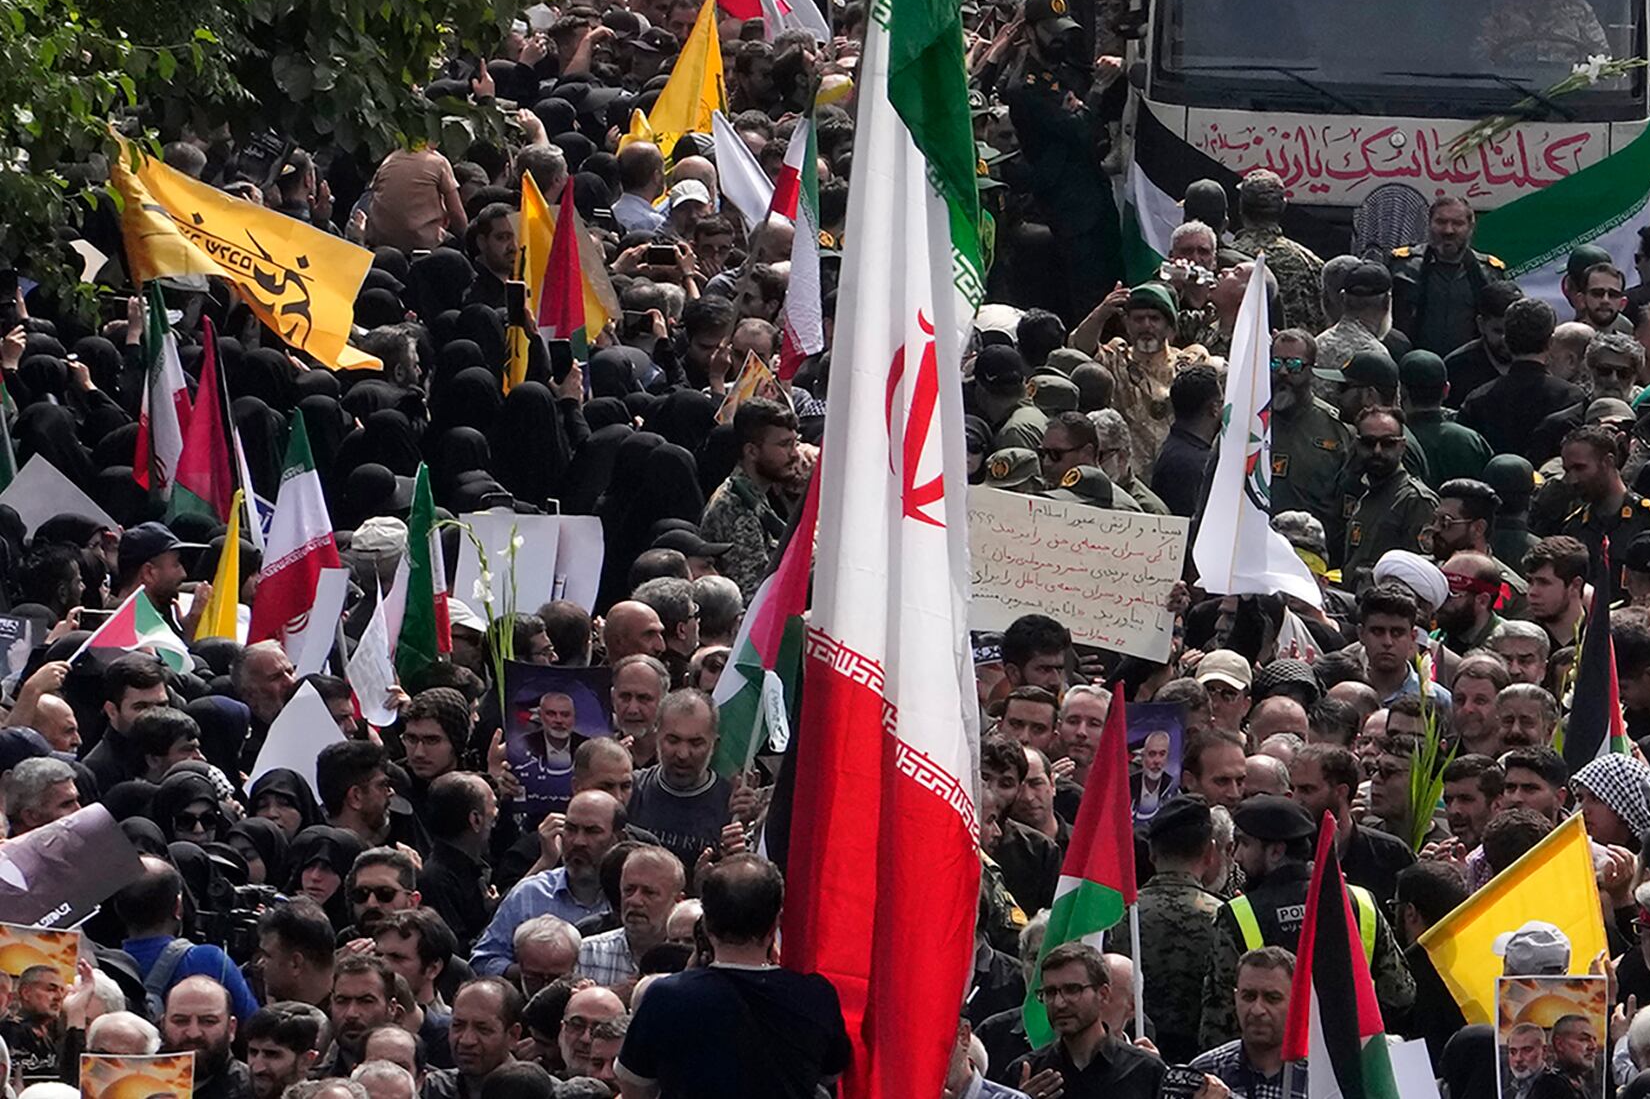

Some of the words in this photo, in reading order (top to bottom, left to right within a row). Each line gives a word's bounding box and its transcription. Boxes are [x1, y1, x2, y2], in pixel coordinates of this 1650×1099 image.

[1100, 517, 1132, 534] ارتش
[1136, 527, 1145, 538] و
[1152, 517, 1182, 540] سپاه
